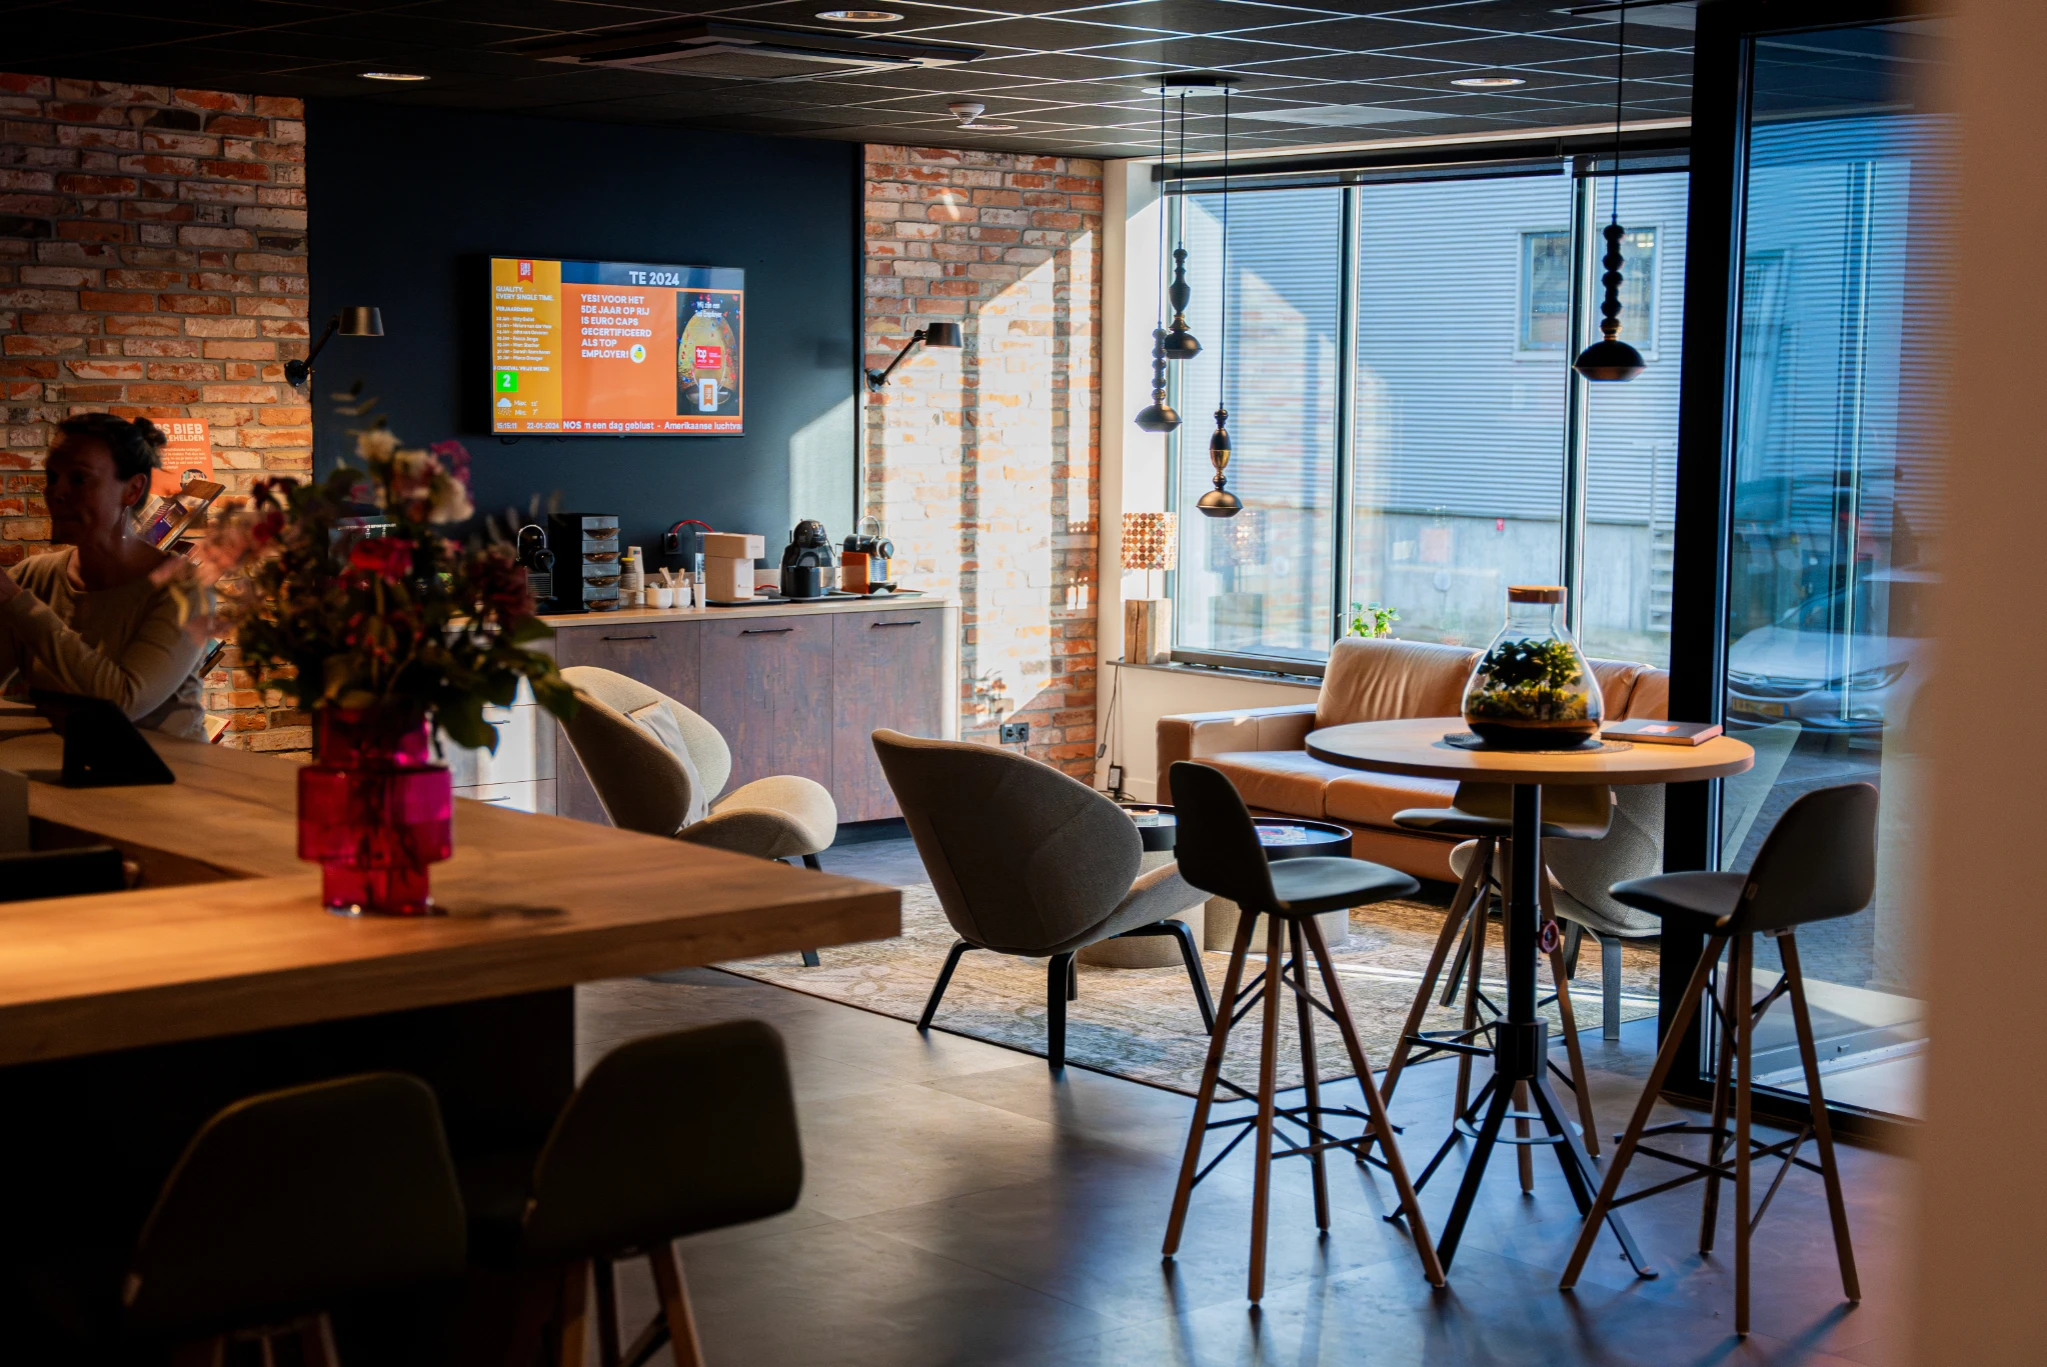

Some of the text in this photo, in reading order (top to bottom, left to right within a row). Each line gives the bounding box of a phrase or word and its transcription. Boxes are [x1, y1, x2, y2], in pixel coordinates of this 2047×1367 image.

[629, 271, 680, 286] TE 2024
[581, 294, 644, 304] YES! VOOR HET
[581, 305, 596, 313] 5DE
[598, 306, 621, 314] JAAR
[591, 317, 614, 325] EURO
[616, 318, 638, 326] CAPS
[581, 327, 652, 337] GECERTIFICEERD
[581, 350, 628, 358] EMPLOYER!
[503, 374, 511, 387] 2
[173, 424, 203, 434] BIEB
[563, 421, 582, 430] NOS
[609, 421, 623, 432] dag
[625, 421, 654, 431] geblust
[664, 421, 712, 430] Amerikaanse
